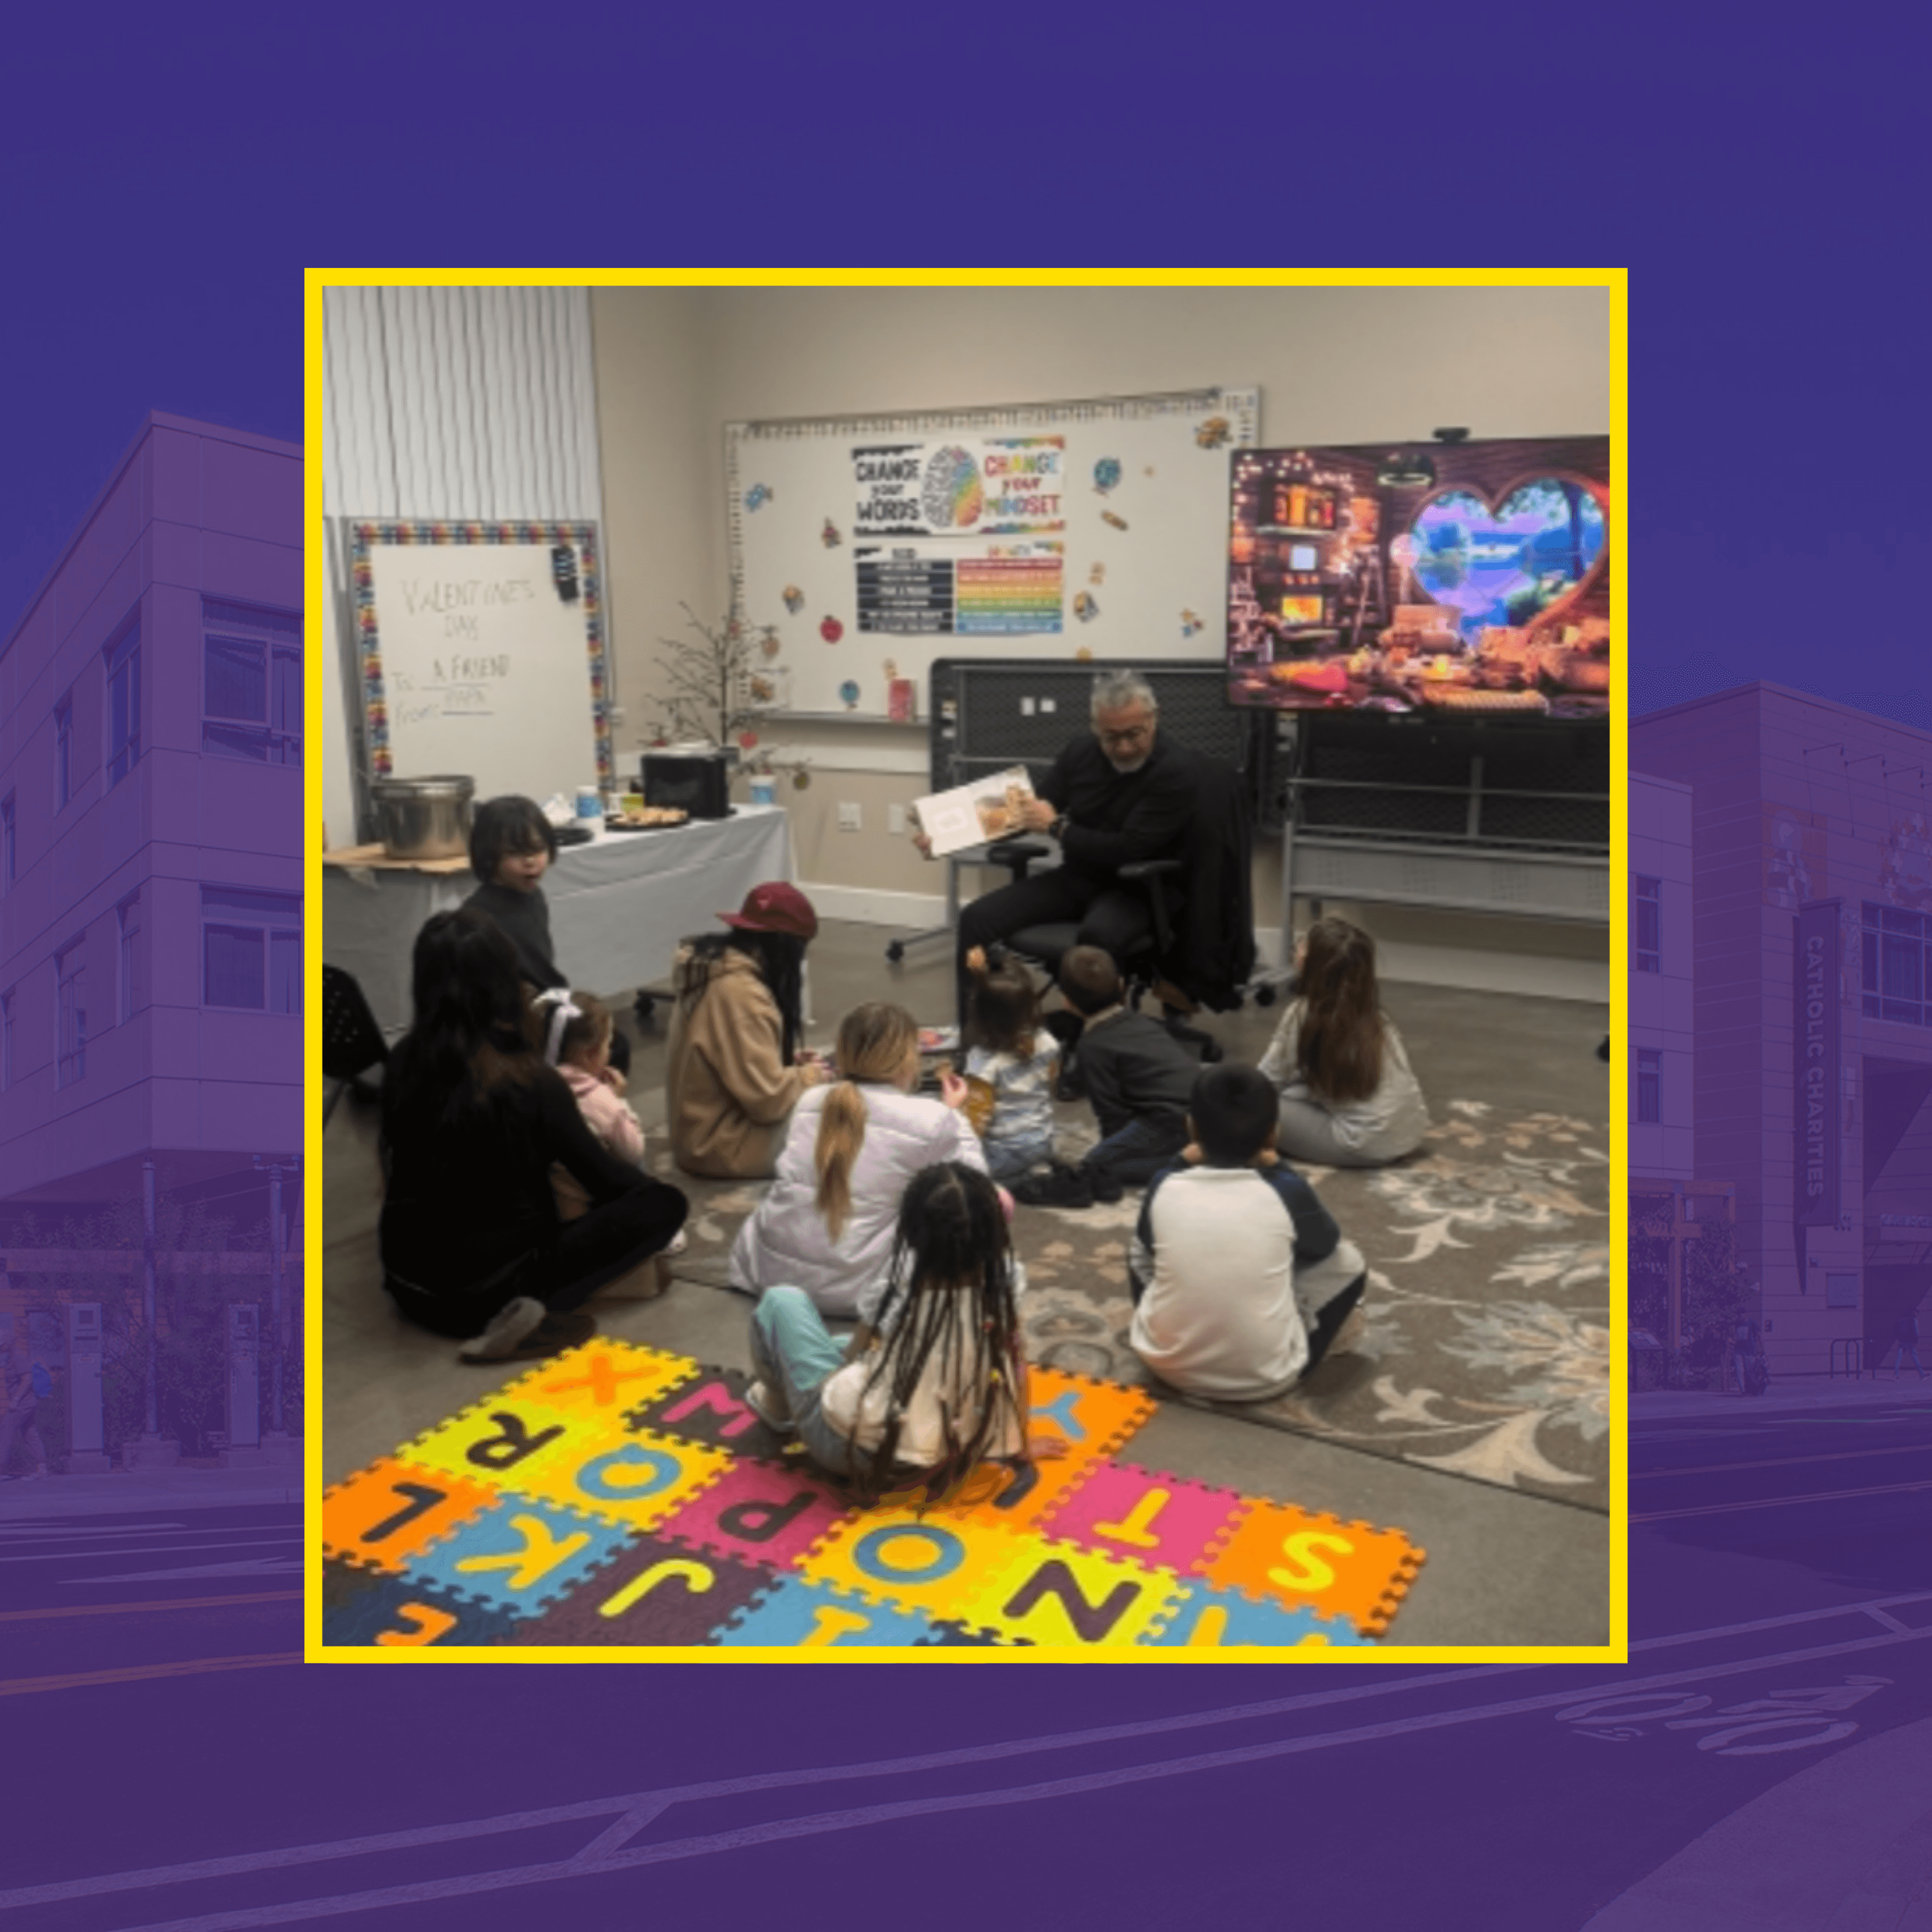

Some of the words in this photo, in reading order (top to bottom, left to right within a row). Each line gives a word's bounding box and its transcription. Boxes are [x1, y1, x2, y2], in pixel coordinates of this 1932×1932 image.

[855, 459, 921, 482] CHANGE
[985, 453, 1060, 477] CHANGE
[856, 497, 921, 521] WORDS
[986, 494, 1060, 517] MINDSET
[1806, 935, 1825, 1058] CATHOLIC
[1806, 1066, 1825, 1198] CHARITIES
[541, 1355, 662, 1405] X
[465, 1413, 567, 1470] R
[1028, 1390, 1087, 1442] Y
[360, 1481, 448, 1544] L
[718, 1490, 818, 1542] P
[1092, 1487, 1170, 1548] T
[455, 1514, 593, 1590] K
[852, 1523, 965, 1585] O
[1267, 1531, 1355, 1591] S
[598, 1558, 715, 1618] J
[1002, 1559, 1143, 1643] N
